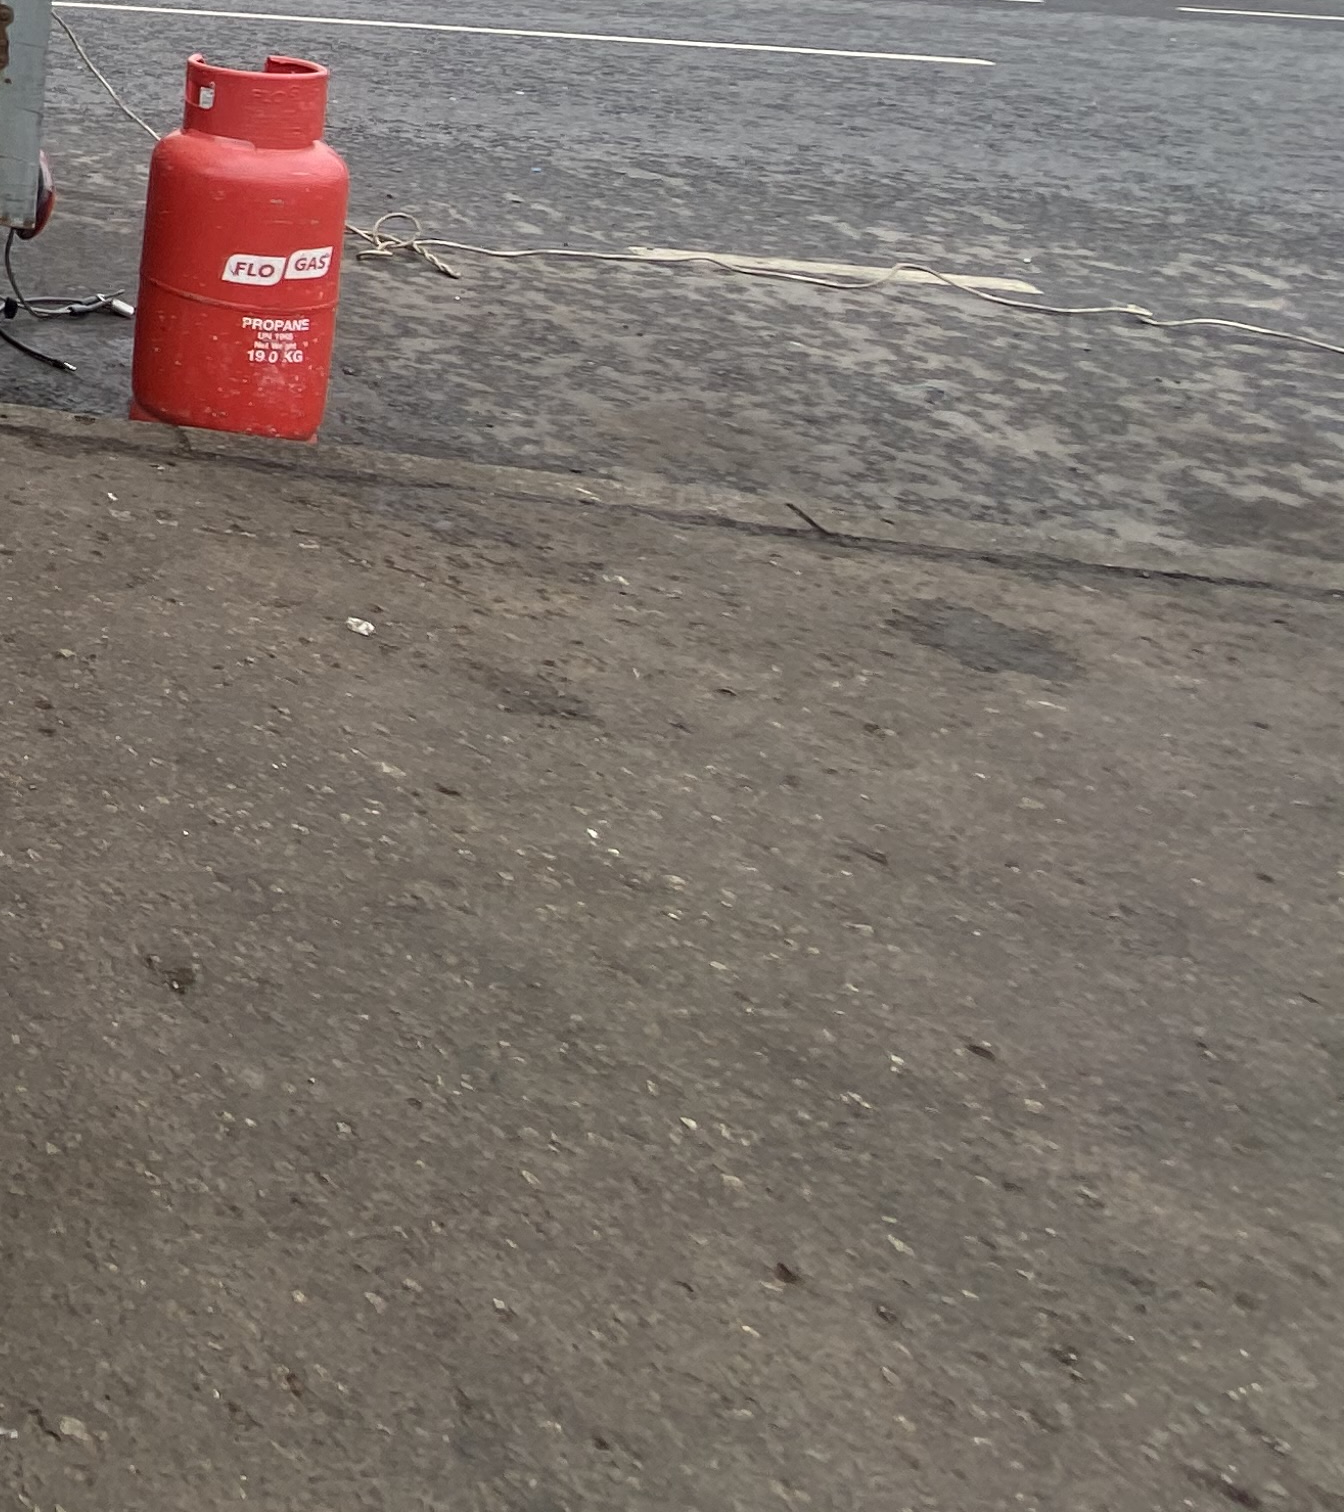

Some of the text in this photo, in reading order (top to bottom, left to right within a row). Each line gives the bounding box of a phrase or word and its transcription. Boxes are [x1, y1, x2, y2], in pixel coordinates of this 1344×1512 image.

[233, 254, 326, 278] FLO GAS
[241, 316, 310, 332] PROPANE
